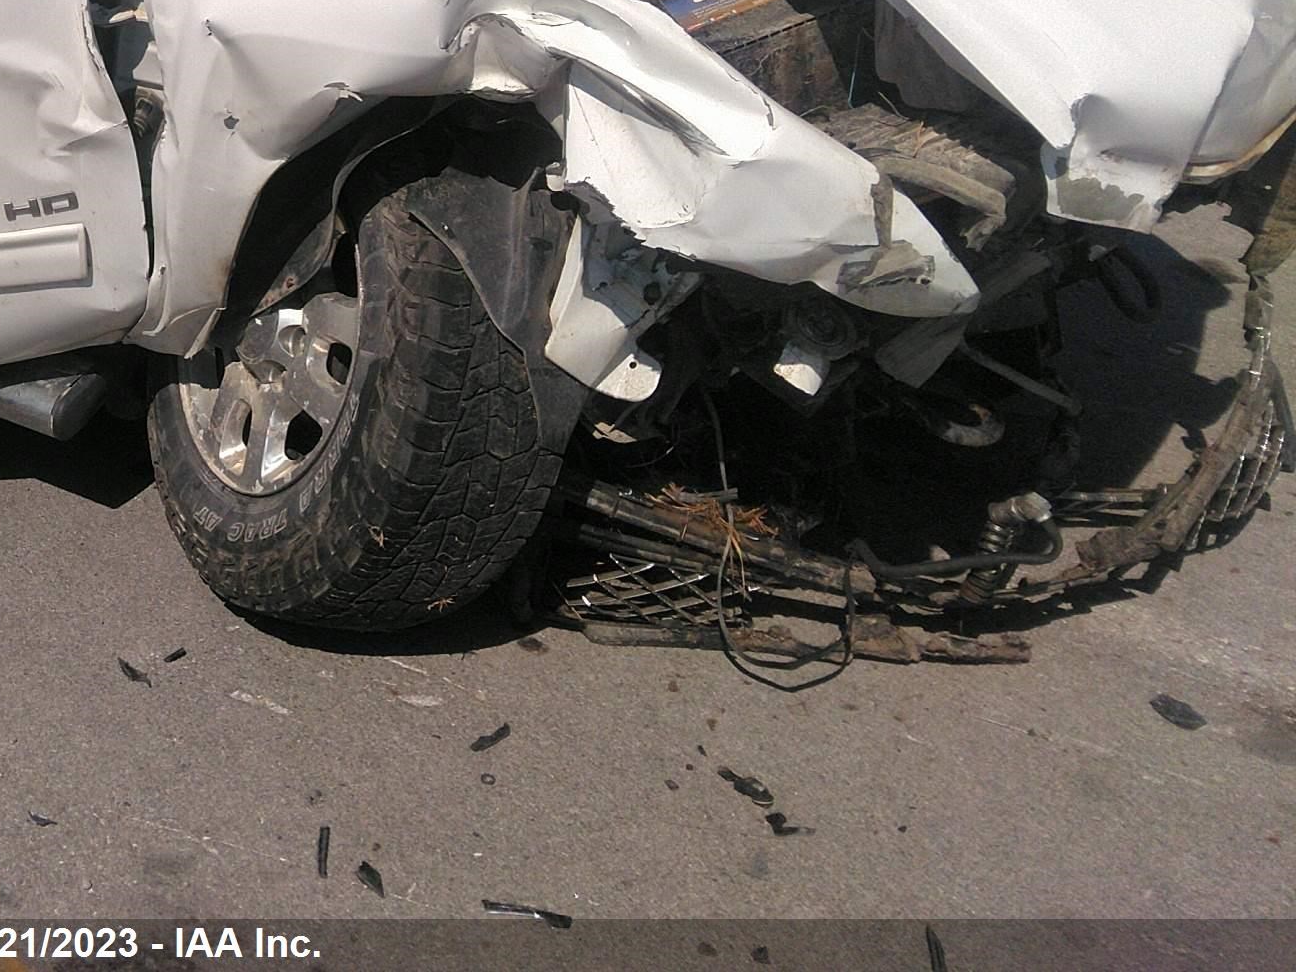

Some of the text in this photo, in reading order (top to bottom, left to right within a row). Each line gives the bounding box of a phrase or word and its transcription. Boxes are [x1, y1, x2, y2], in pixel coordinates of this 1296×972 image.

[3, 191, 79, 222] HD
[194, 506, 223, 531] AT
[227, 508, 288, 543] TRAC
